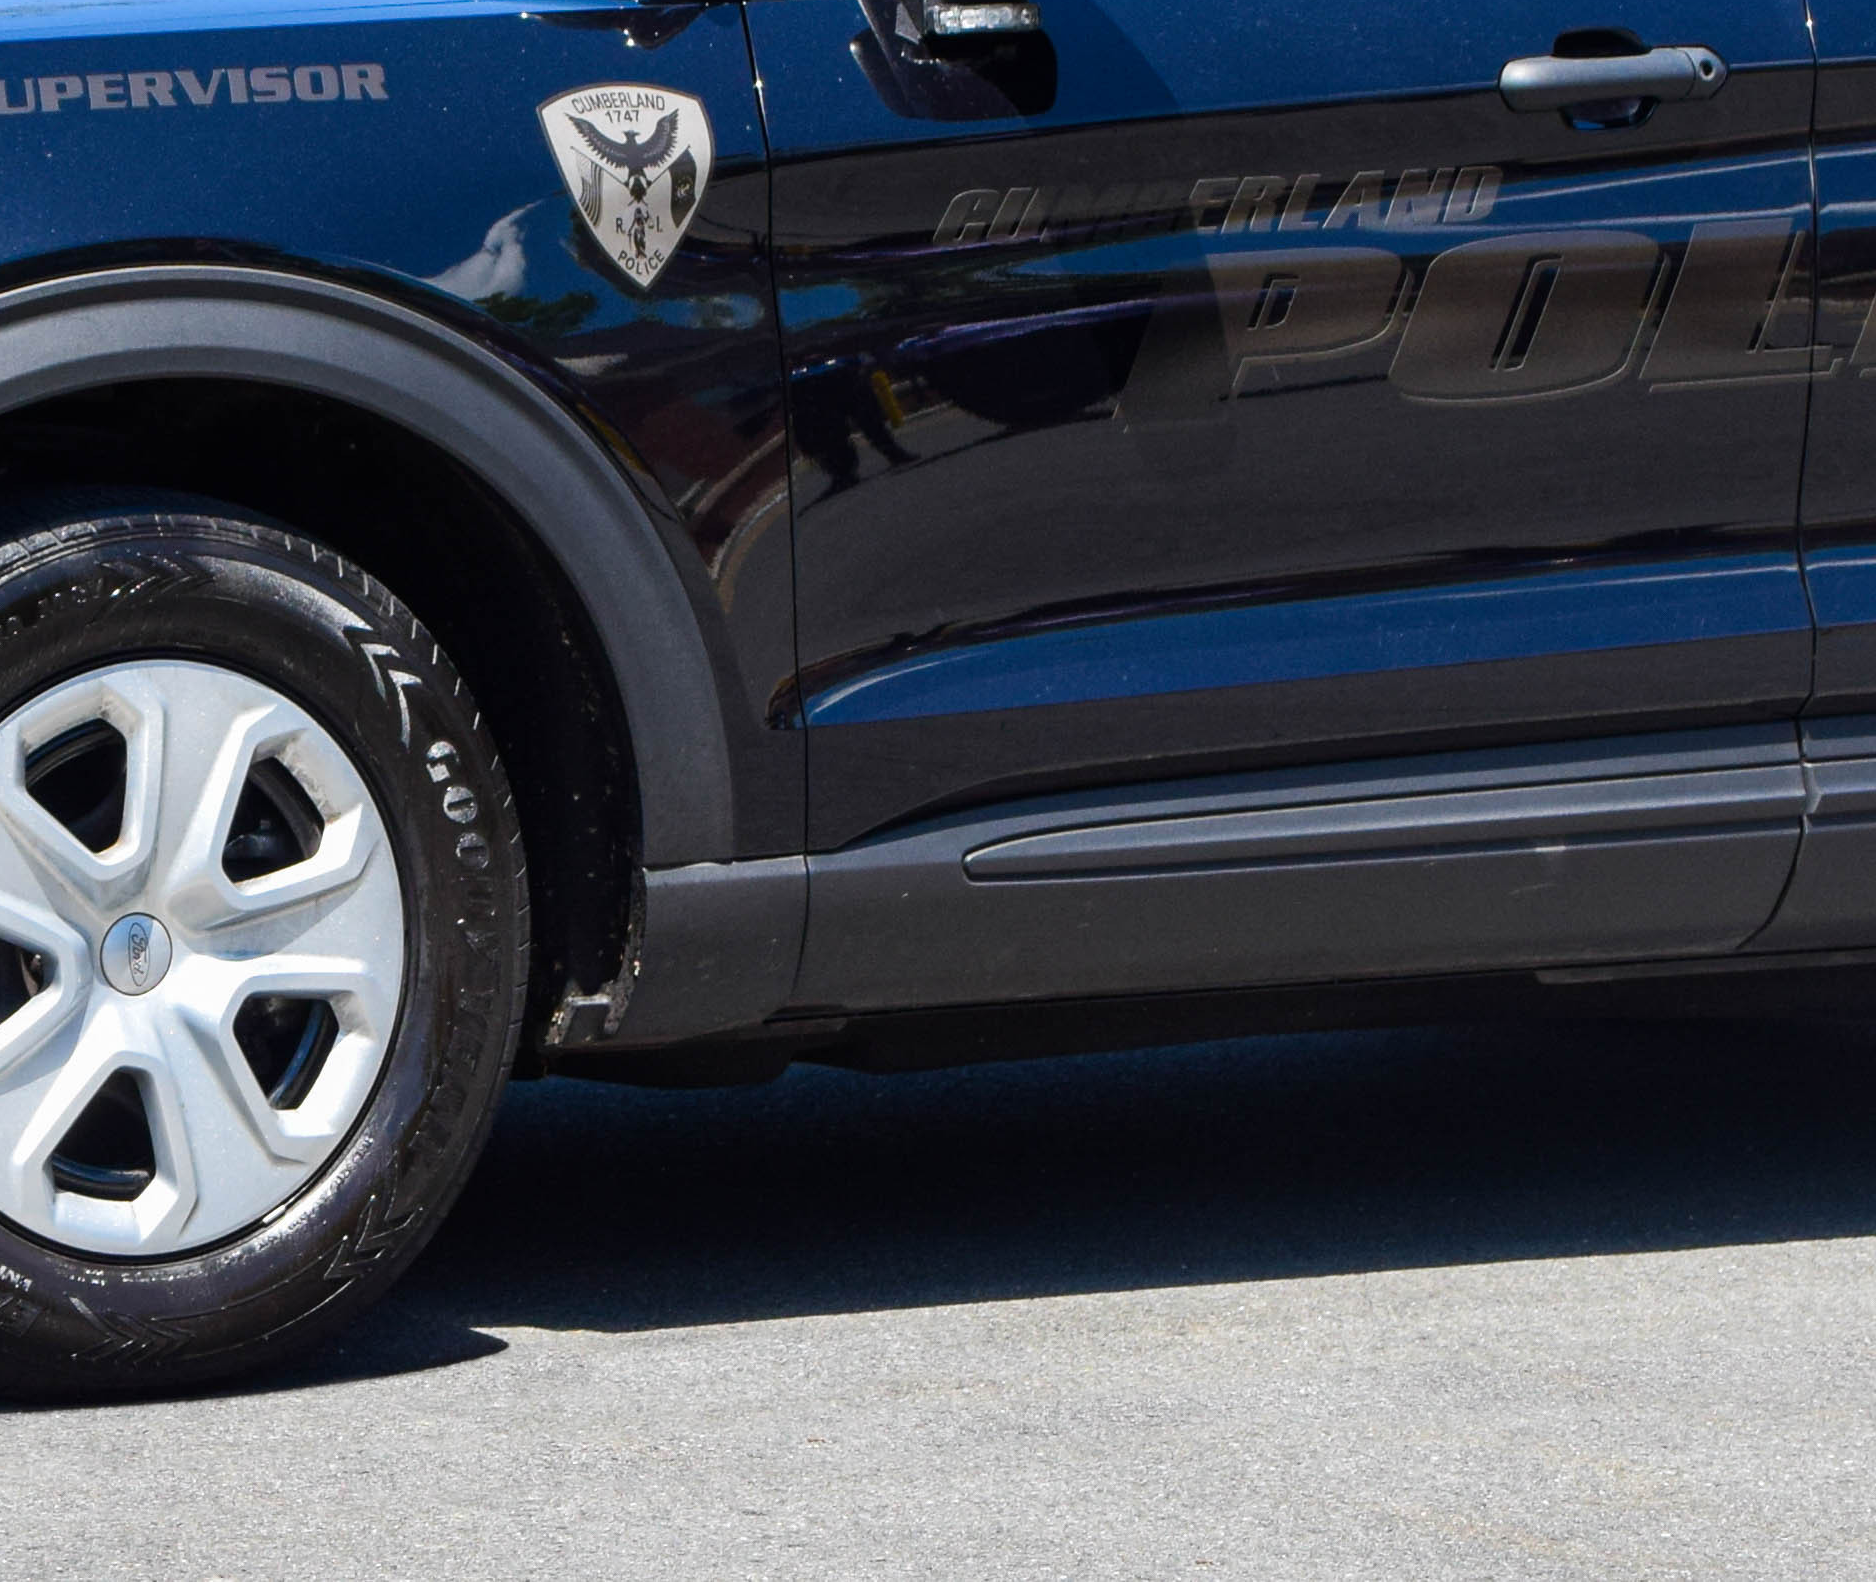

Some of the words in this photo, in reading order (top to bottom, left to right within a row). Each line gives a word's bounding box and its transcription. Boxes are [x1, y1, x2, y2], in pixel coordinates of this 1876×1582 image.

[571, 92, 666, 114] CUMBERLAND
[605, 109, 640, 124] 1747
[618, 249, 665, 275] POLICE
